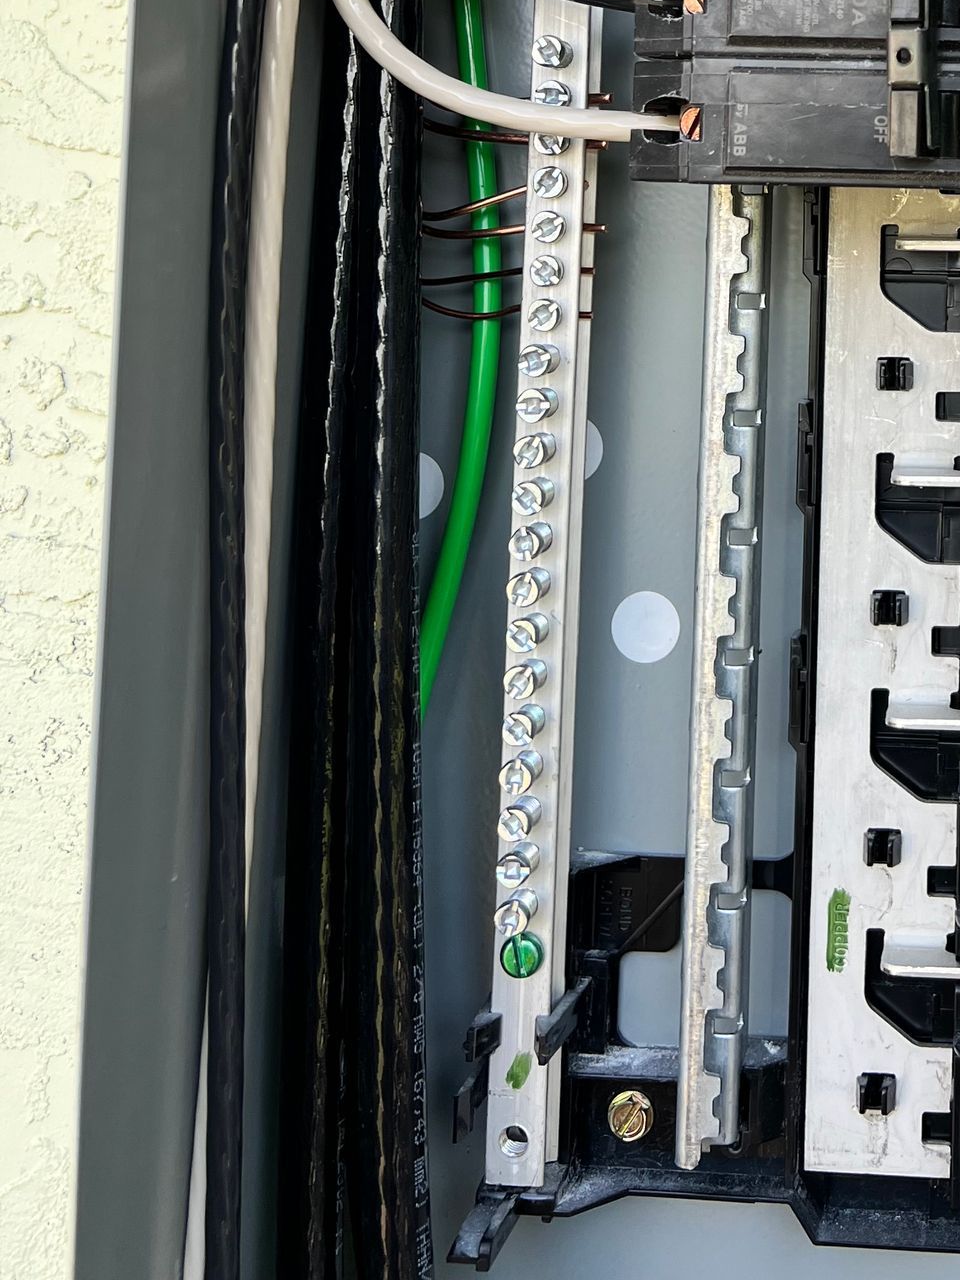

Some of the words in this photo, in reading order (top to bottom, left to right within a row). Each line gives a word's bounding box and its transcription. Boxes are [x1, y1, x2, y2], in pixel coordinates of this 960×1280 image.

[733, 123, 748, 156] ABB
[873, 115, 888, 144] OFF
[832, 902, 850, 970] COPPER
